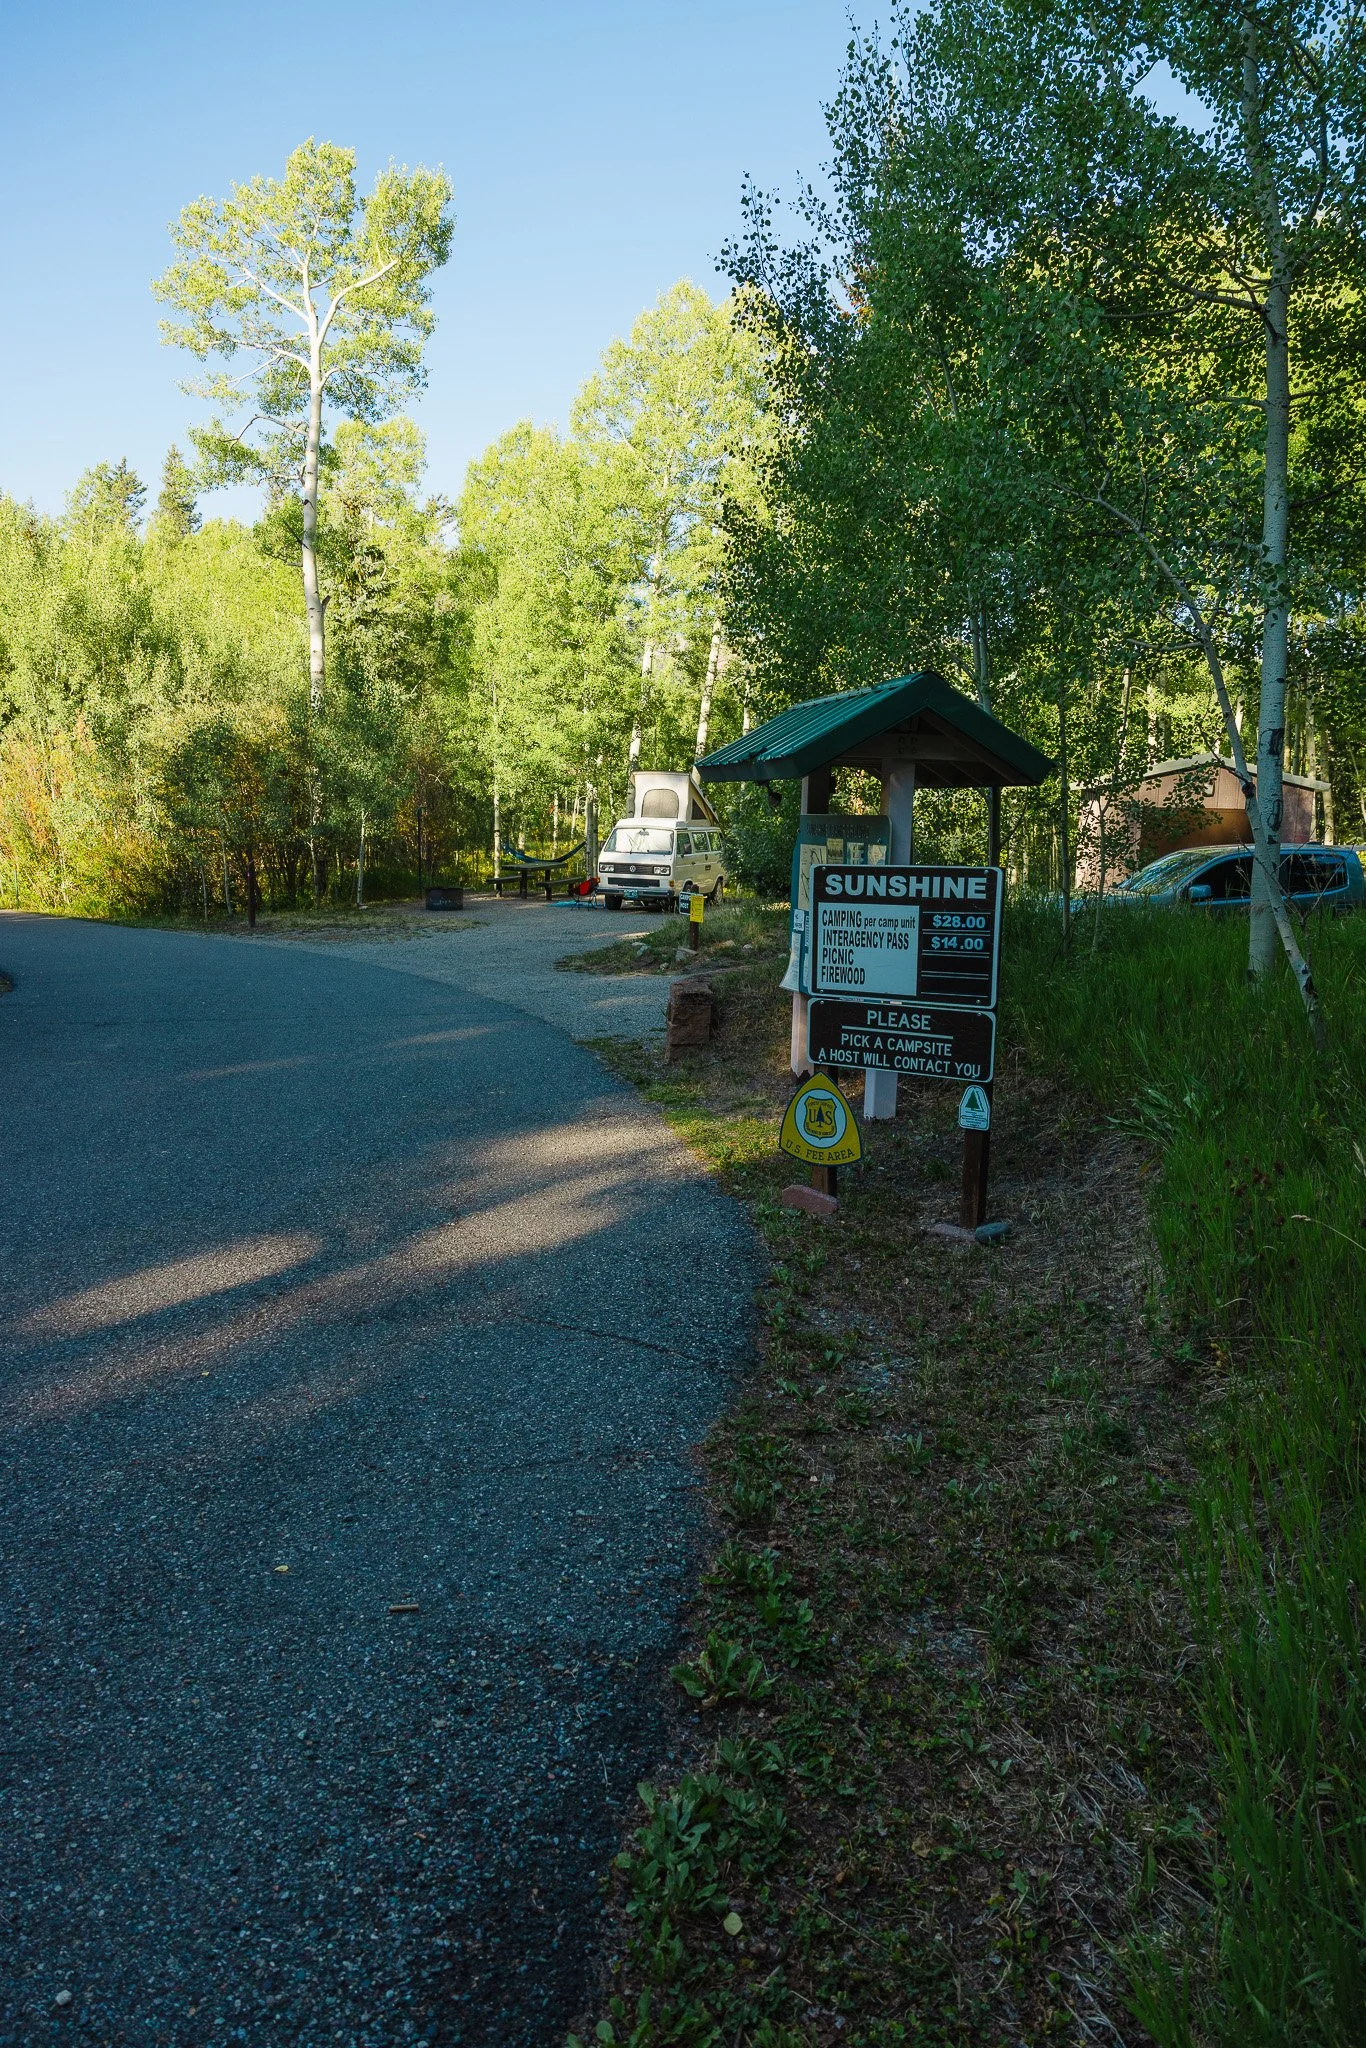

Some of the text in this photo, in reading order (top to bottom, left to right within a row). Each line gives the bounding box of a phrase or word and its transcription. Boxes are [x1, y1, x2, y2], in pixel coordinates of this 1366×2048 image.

[825, 874, 987, 900] SUNSHINE
[822, 909, 916, 931] CAMPING per camp unit
[932, 914, 986, 929] $28.00
[823, 929, 885, 949] INTERAGENCY
[886, 932, 909, 950] PASS
[822, 947, 855, 965] PICNIC
[821, 965, 866, 985] FIREWOOD
[867, 1009, 931, 1031] PLEASE
[841, 1033, 953, 1057] PICK A CAMPSITE
[818, 1047, 981, 1077] A HOST WILL CONTACT YOU
[785, 1139, 855, 1161] U.S. FEE AREA
